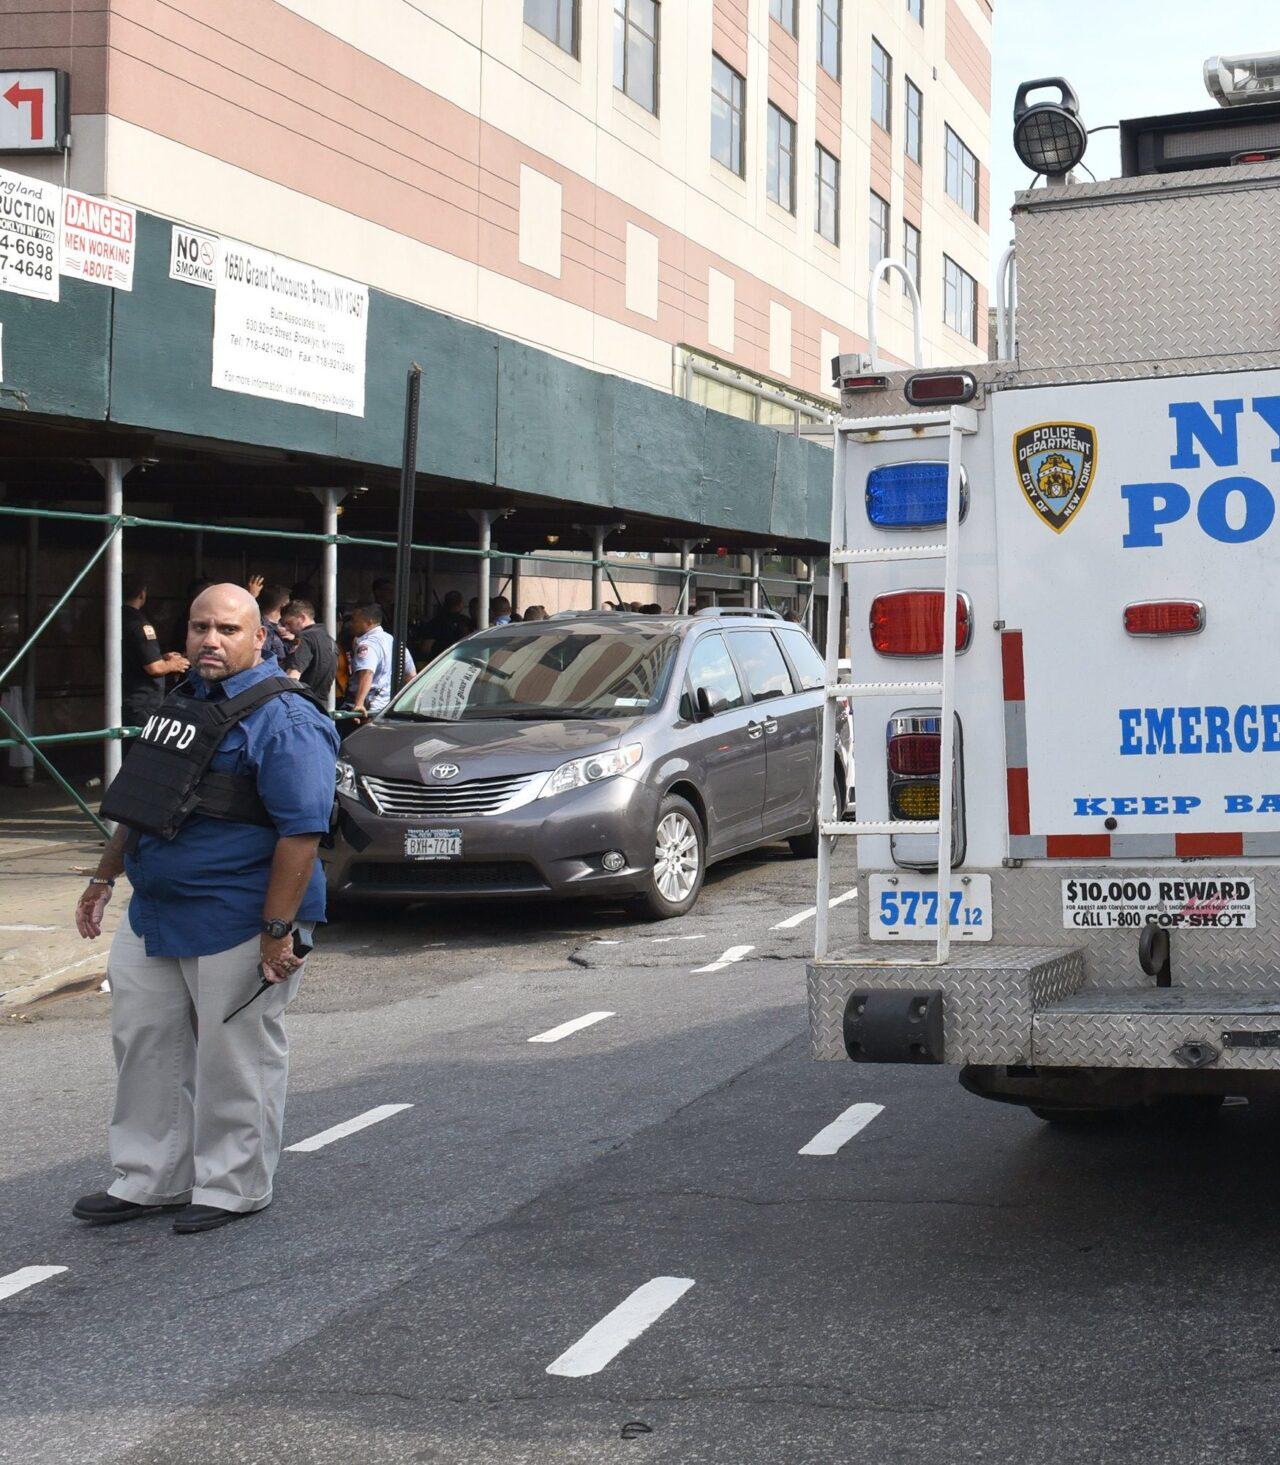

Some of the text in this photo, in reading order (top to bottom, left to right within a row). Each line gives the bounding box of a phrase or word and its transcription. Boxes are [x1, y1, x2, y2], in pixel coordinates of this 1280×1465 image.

[0, 180, 43, 199] ngland
[0, 195, 55, 228] UCTION
[66, 197, 131, 241] DANGER
[64, 232, 130, 265] MEN WORKING
[177, 233, 199, 262] NO
[83, 260, 113, 281] ABOVE
[175, 260, 213, 282] SMOKING
[225, 252, 244, 282] 1650
[246, 258, 268, 290] Grand
[1033, 426, 1077, 442] POLICE
[1019, 437, 1092, 461] DEPARTMENT
[1022, 472, 1050, 514] CITY OF
[1063, 460, 1092, 517] NEW YORK
[140, 714, 196, 750] NYPD
[1073, 795, 1202, 816] KEEP
[1067, 880, 1251, 904] $10,000 REWARD
[964, 907, 983, 926] 12
[1073, 911, 1246, 927] CALL 1-800 COP-SHOT
